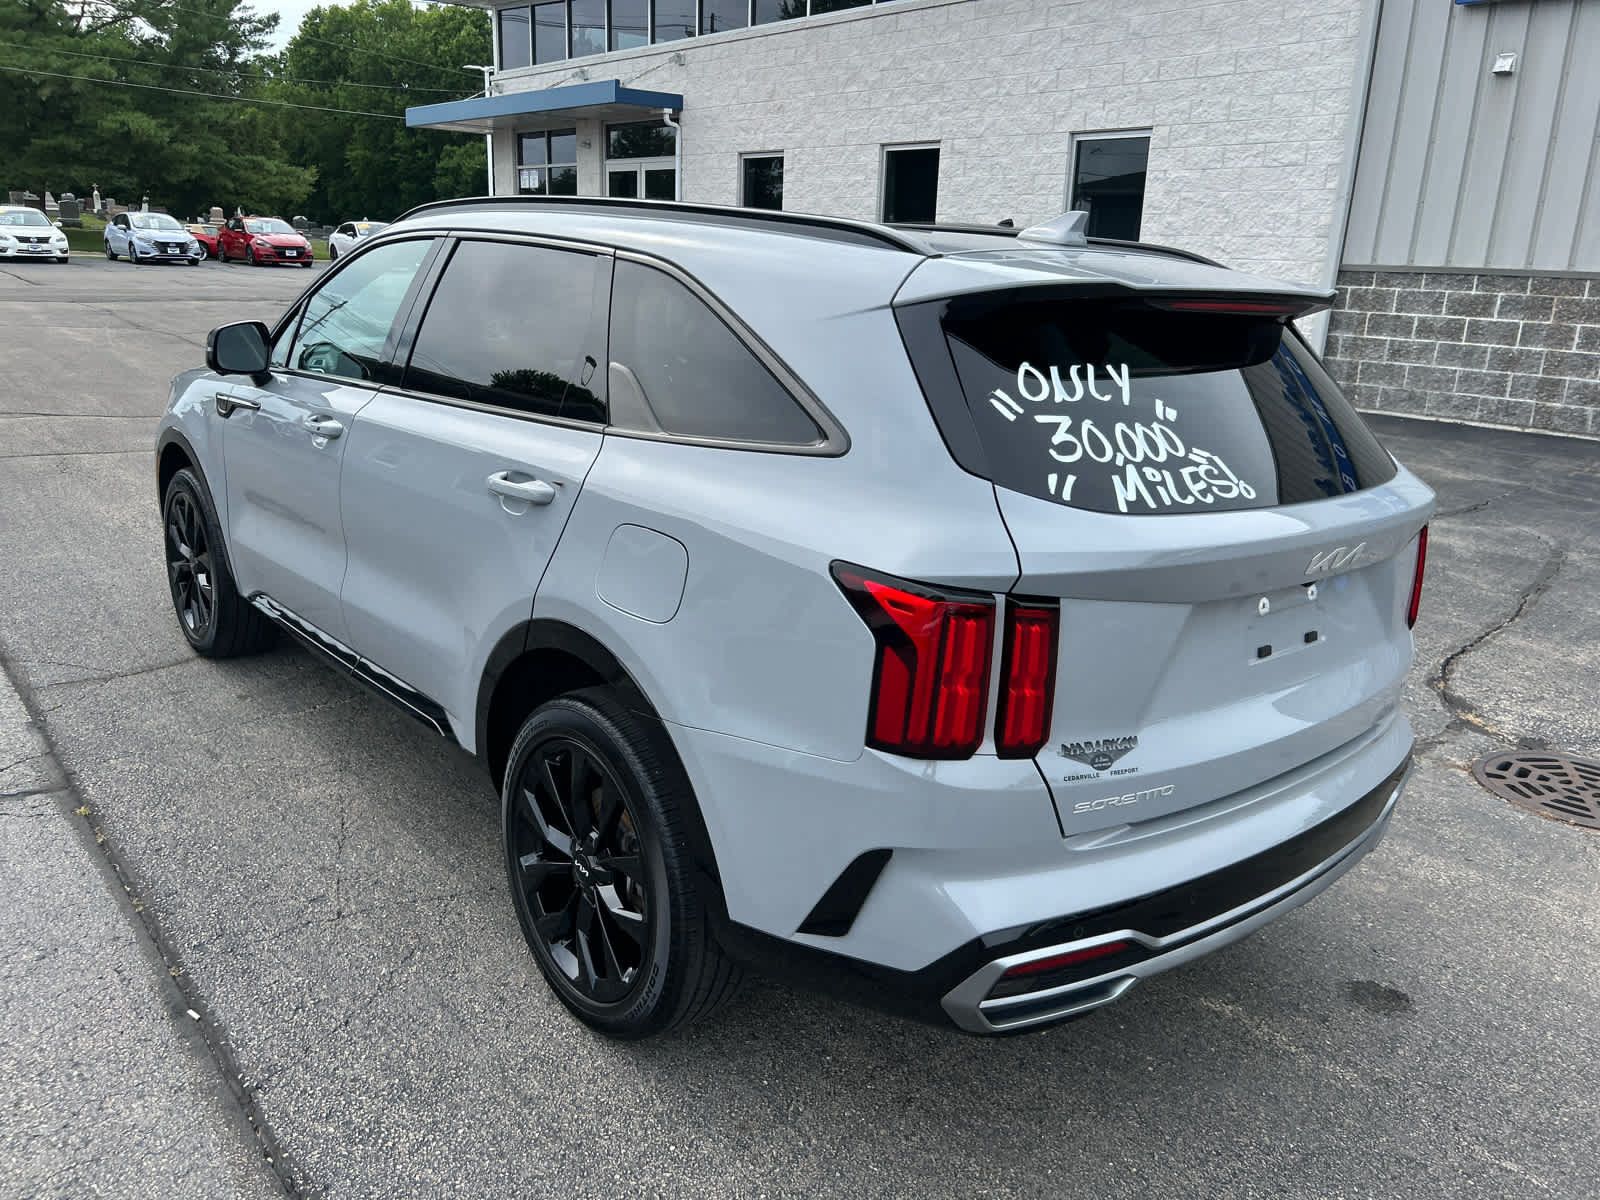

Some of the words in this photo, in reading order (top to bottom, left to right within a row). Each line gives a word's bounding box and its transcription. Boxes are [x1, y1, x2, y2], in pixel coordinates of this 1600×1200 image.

[1017, 361, 1130, 406] ONLY
[1034, 415, 1186, 467] 30,000
[1303, 541, 1367, 576] KIA
[1063, 772, 1101, 782] CEDARVILLE
[1110, 767, 1139, 777] FREEPORT
[1072, 783, 1177, 814] SORENTO
